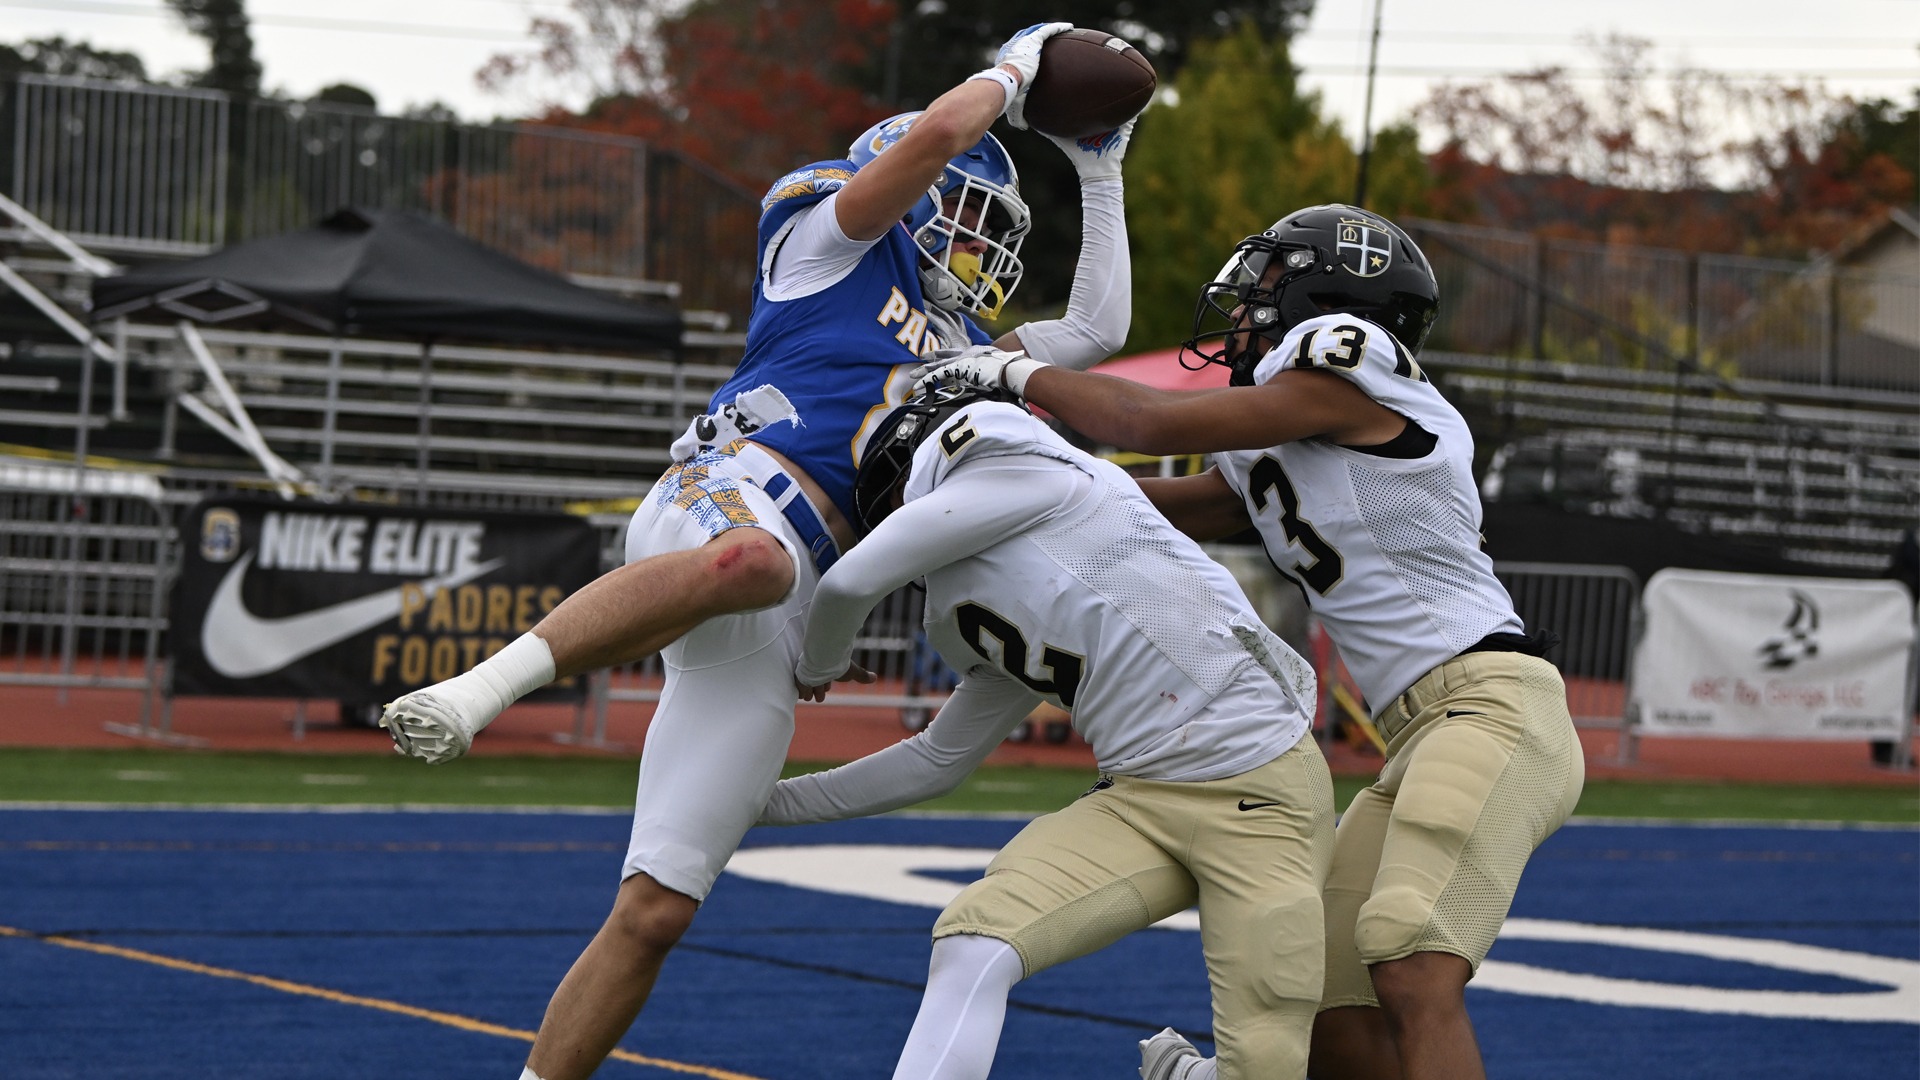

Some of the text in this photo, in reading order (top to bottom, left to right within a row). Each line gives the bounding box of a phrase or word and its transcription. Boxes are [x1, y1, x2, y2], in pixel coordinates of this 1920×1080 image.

[1291, 324, 1370, 373] 13
[258, 511, 487, 575] NIKE ELITE
[953, 599, 1087, 713] 2
